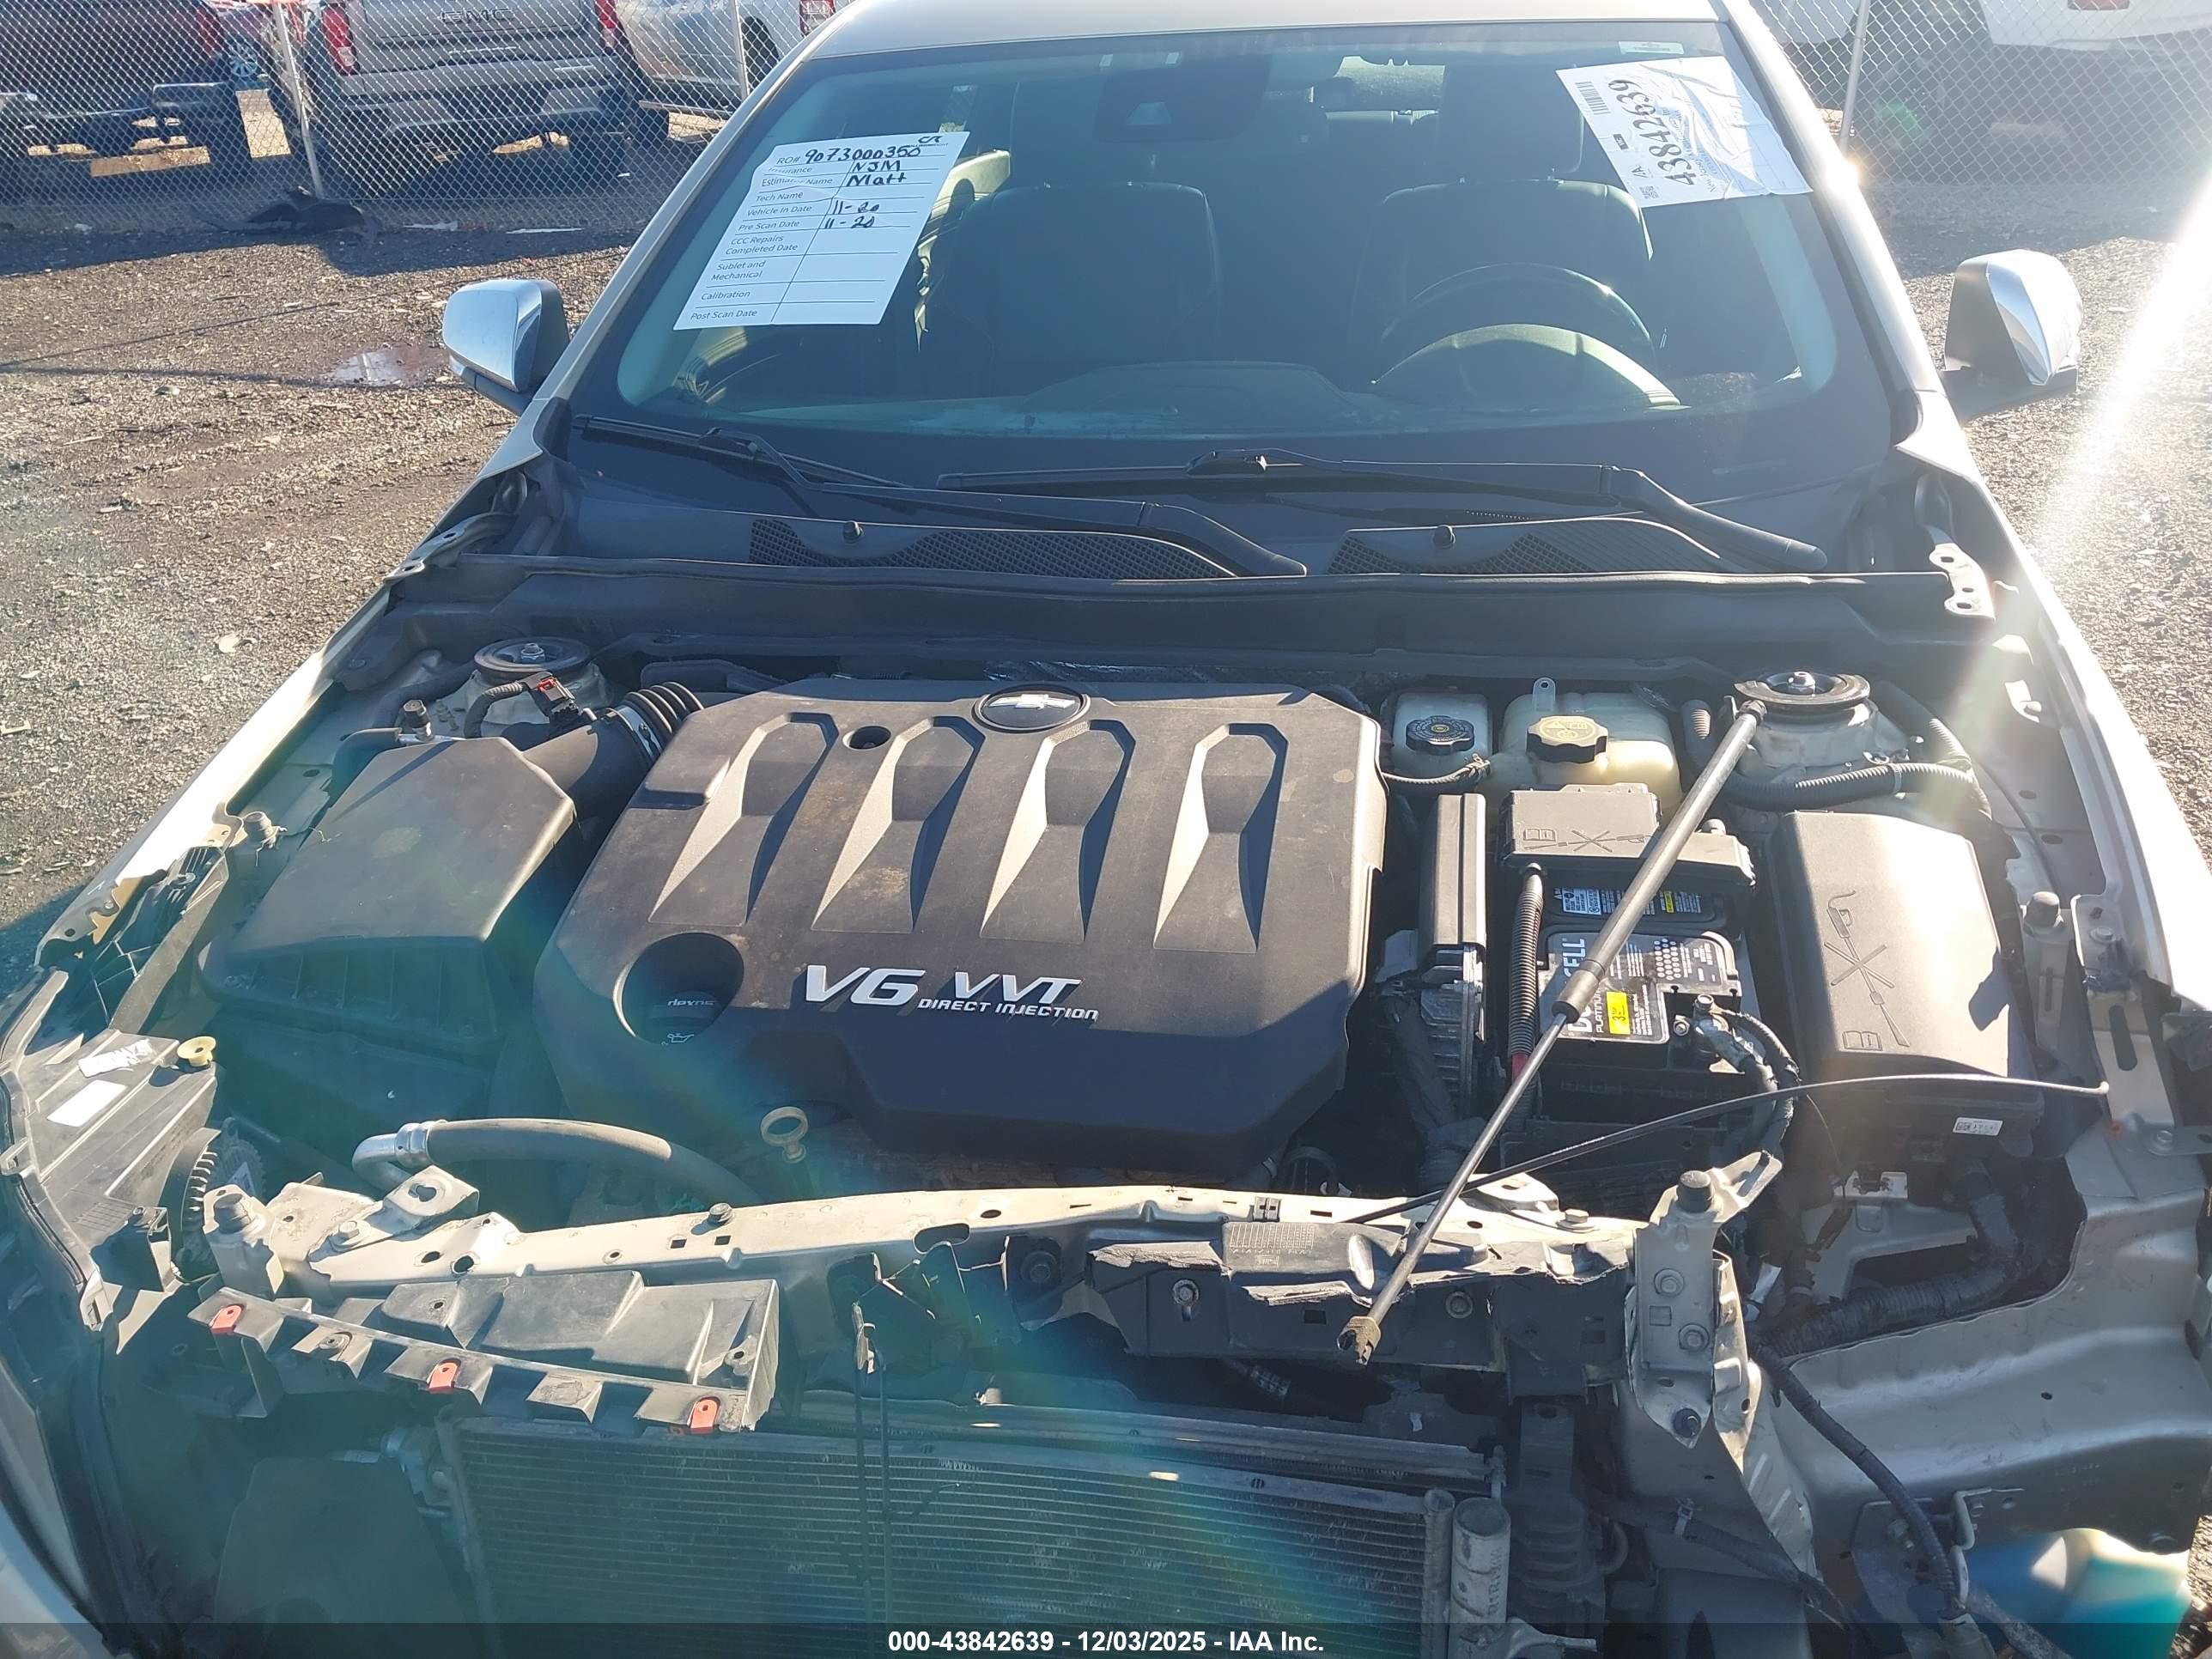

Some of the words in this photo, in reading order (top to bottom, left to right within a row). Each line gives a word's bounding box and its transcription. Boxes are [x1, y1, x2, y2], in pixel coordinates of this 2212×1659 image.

[441, 8, 514, 23] GMC
[1608, 79, 1696, 185] 43842639
[776, 155, 800, 165] RO#
[805, 146, 921, 164] 9073000350
[852, 160, 901, 173] NJM
[762, 177, 805, 187] Estima
[805, 177, 833, 185] Name
[846, 172, 908, 187] Matt
[756, 194, 775, 203] Tech
[747, 209, 779, 217] Vehicle
[750, 234, 784, 245] Repairs
[726, 244, 775, 255] Completed
[776, 243, 799, 252] Date
[716, 262, 746, 271] Sublet
[710, 270, 763, 282] Mechanical
[701, 290, 750, 301] Calibration
[690, 312, 710, 321] Post
[711, 310, 734, 319] Scan
[735, 309, 758, 318] Date
[805, 964, 927, 1006] V6
[955, 971, 1083, 1005] VVT
[1563, 939, 1593, 1033] DELL
[917, 998, 992, 1014] DIRECT
[994, 1002, 1100, 1021] INJECTION
